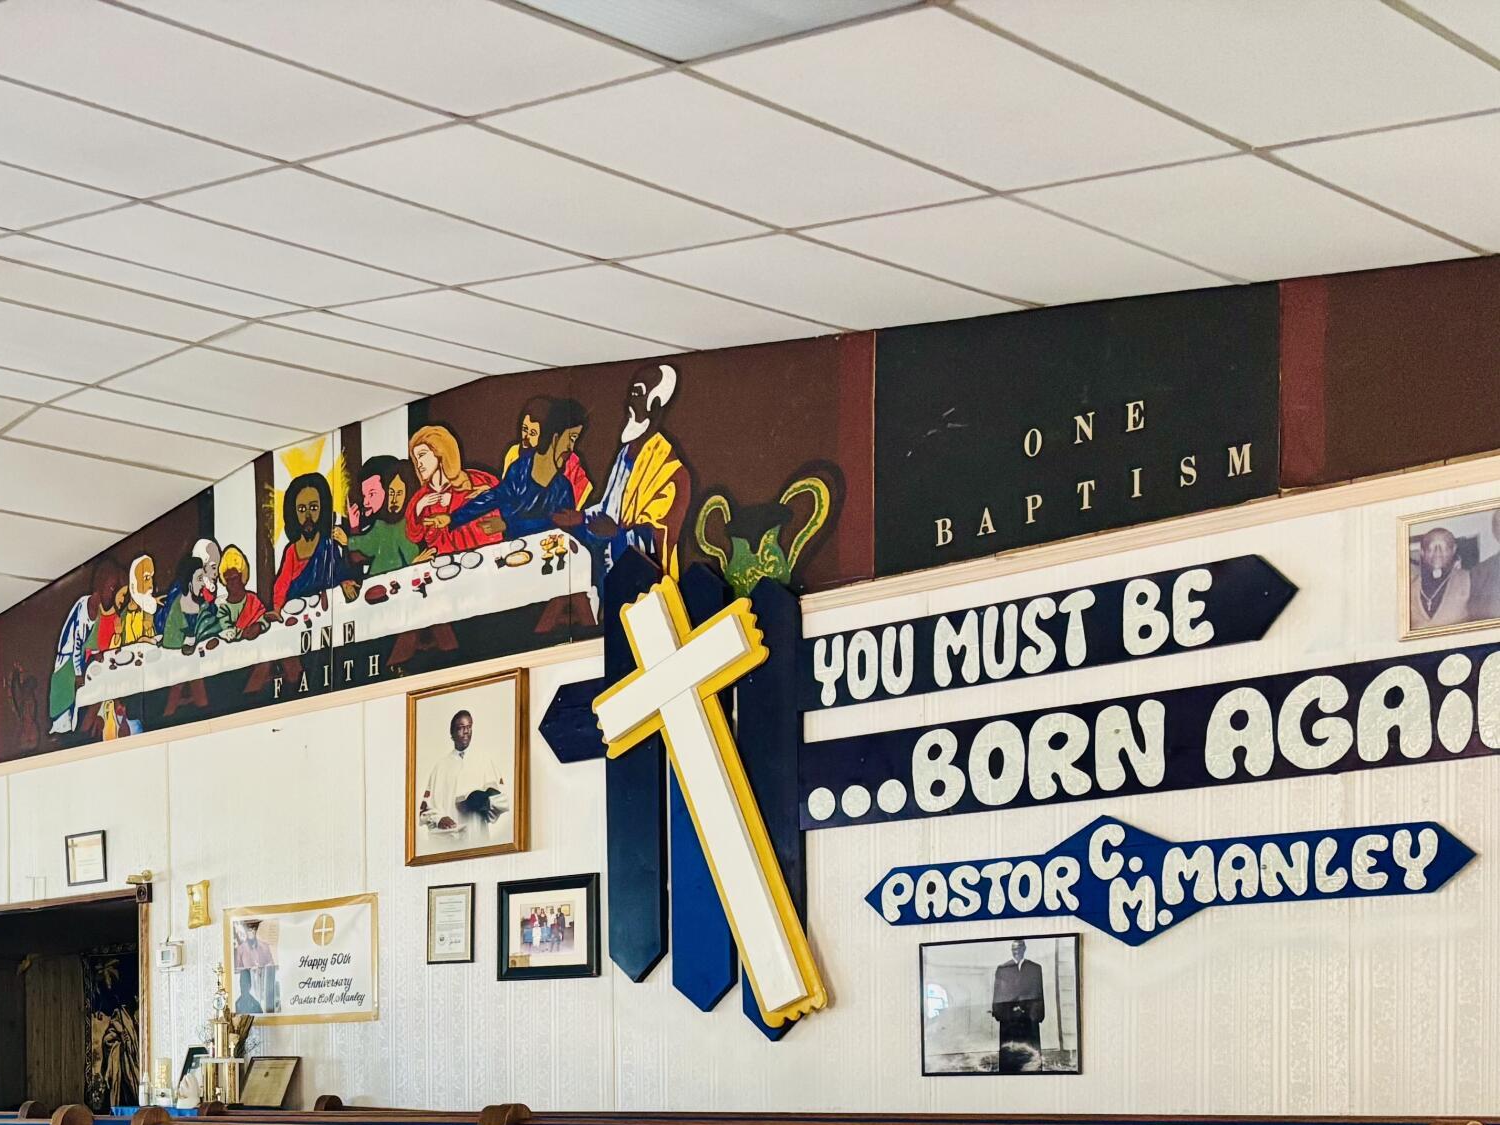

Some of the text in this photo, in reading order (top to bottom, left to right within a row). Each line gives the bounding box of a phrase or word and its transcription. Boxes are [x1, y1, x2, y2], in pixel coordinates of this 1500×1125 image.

[1023, 400, 1146, 458] ONE
[934, 442, 1252, 547] BAPTISM
[301, 621, 354, 653] ONE
[812, 568, 1215, 707] YOU MUST BE
[273, 654, 380, 698] FAITH
[880, 855, 1081, 924] PASTOR
[1162, 828, 1439, 905] MANLEY
[298, 952, 352, 972] Happy 50th
[290, 994, 316, 1006] Pastor
[335, 991, 366, 1007] Manley
[298, 977, 353, 993] Anniversary
